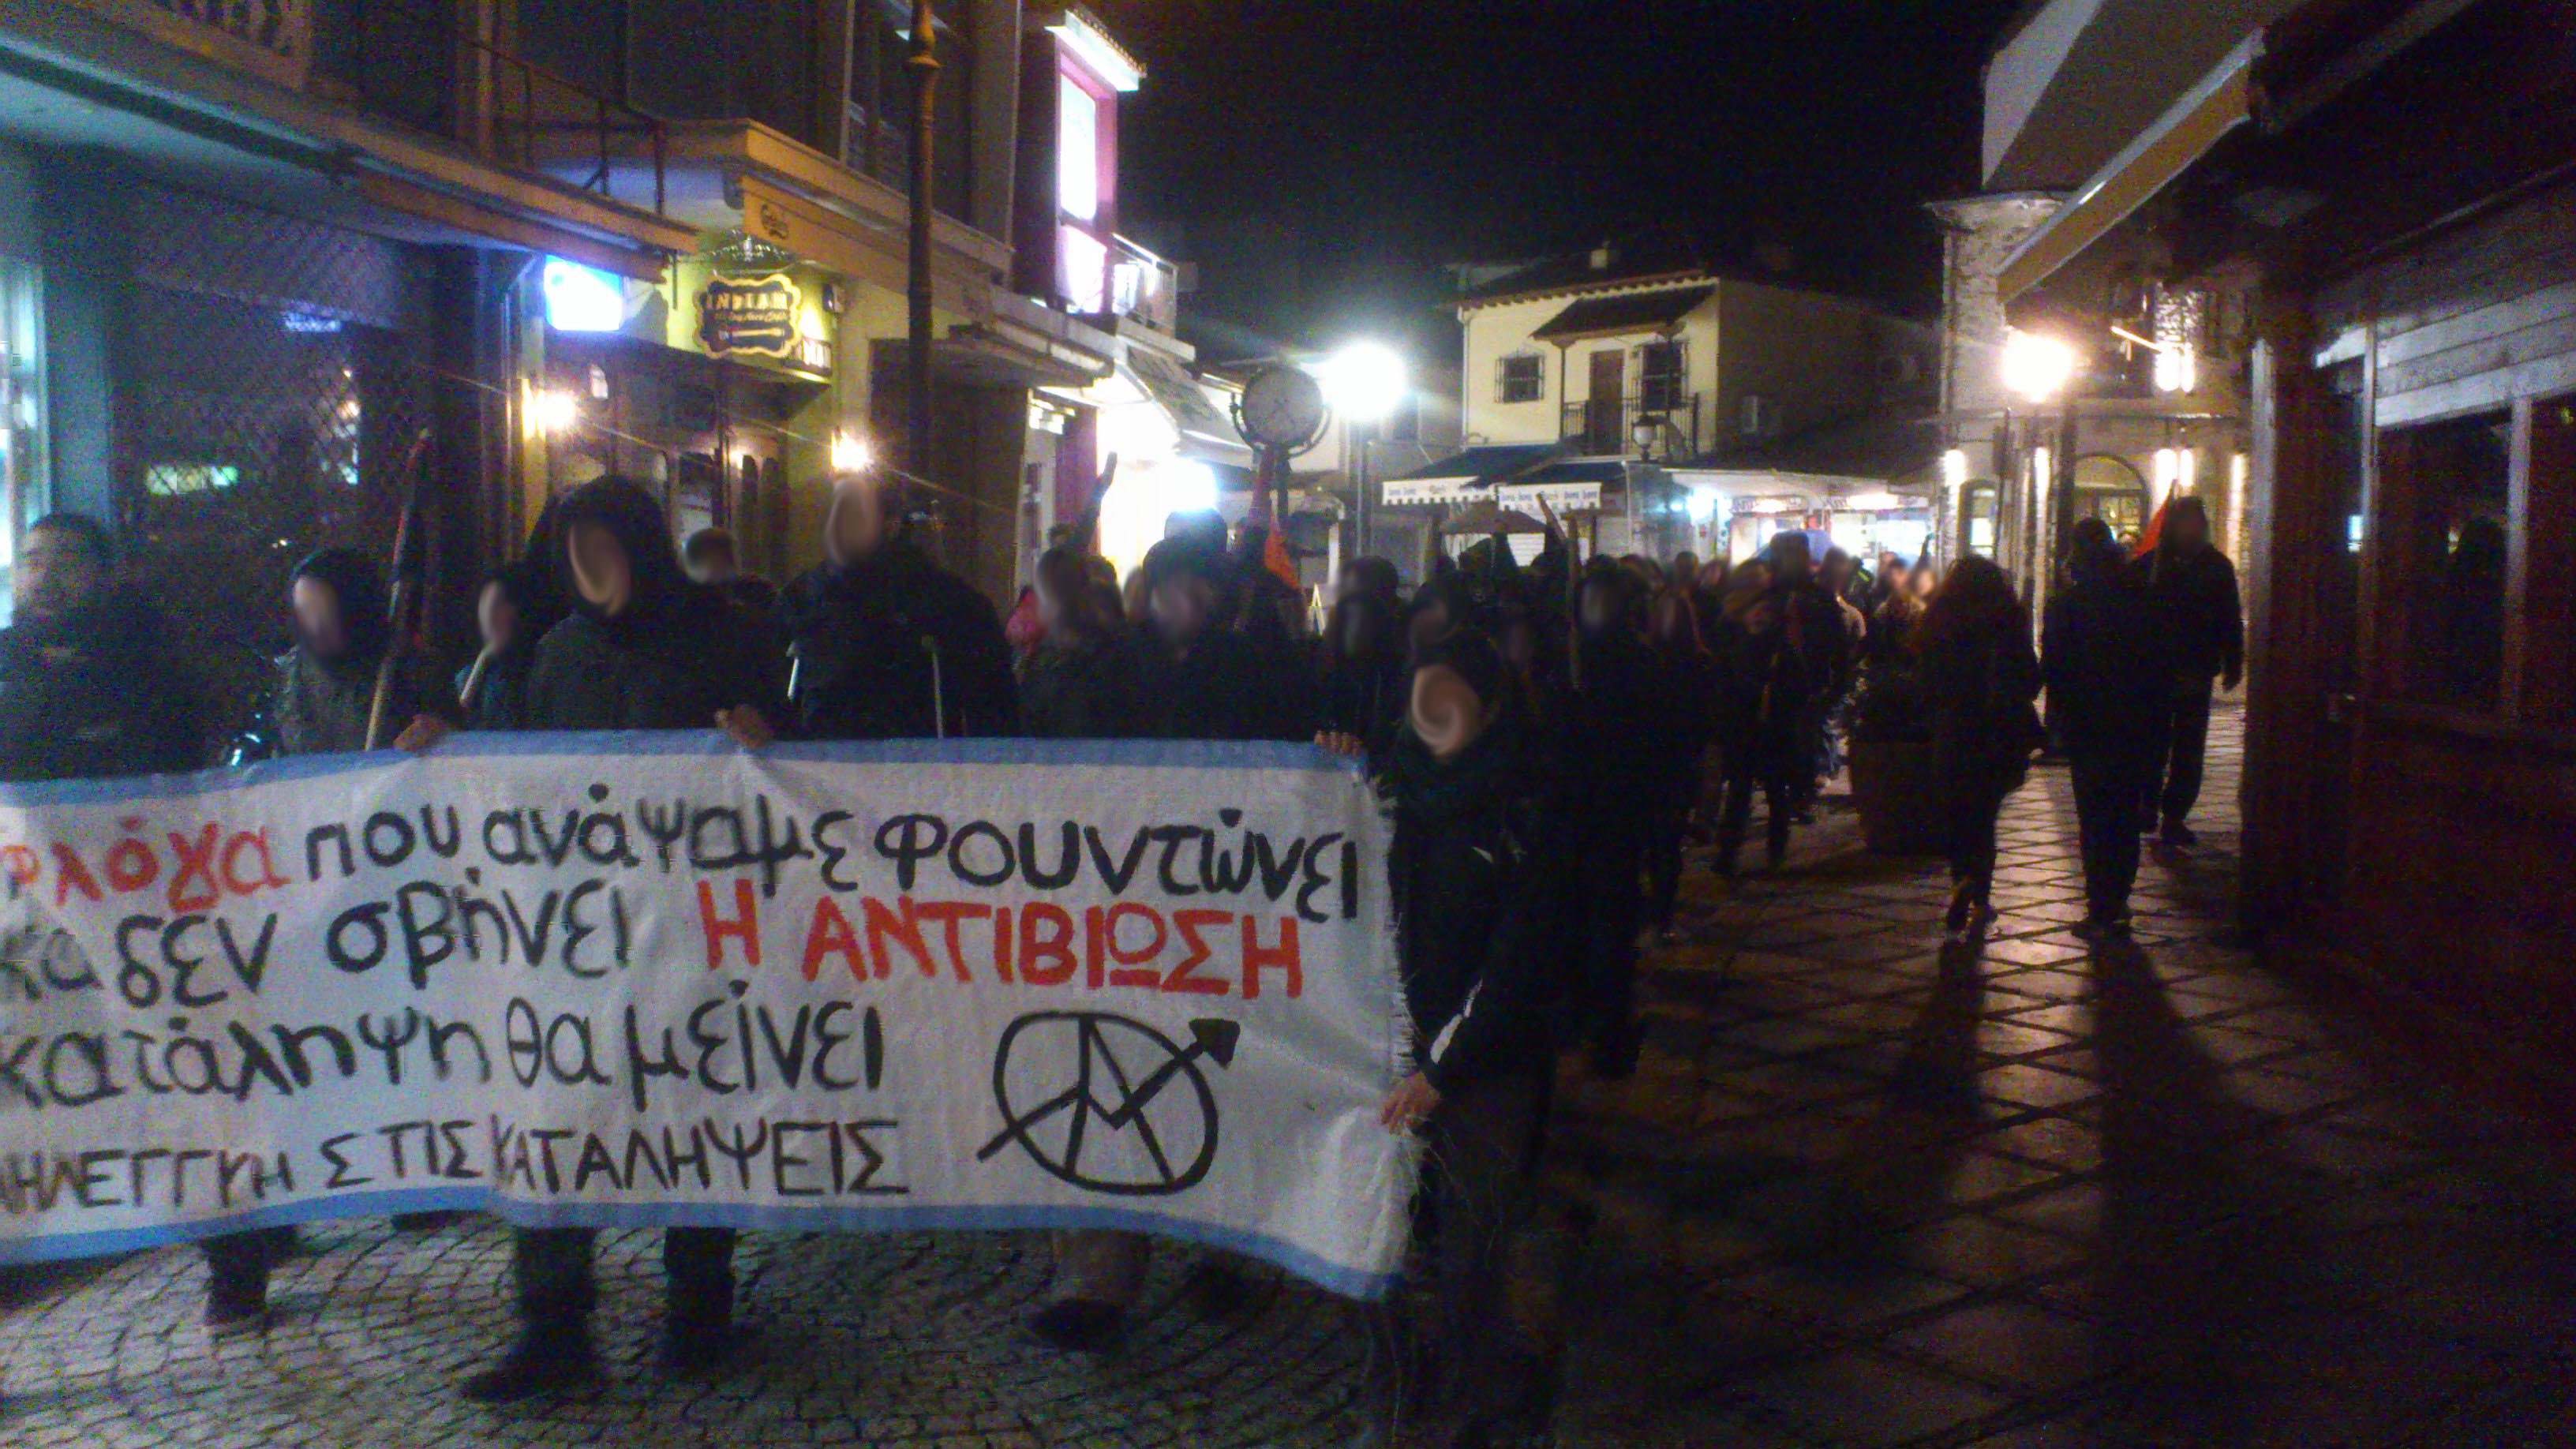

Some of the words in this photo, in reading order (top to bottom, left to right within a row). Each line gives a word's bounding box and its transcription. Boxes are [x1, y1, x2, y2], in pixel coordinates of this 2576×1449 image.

[305, 803, 462, 882] που
[482, 783, 859, 898] ανάψαμε
[115, 912, 278, 1008] δεν
[326, 867, 630, 990] σβήνει
[696, 878, 761, 970] Η
[801, 897, 1303, 1000] ΑΝΤΙΒΙΩΣΗ
[505, 996, 612, 1088] θα
[624, 979, 883, 1113] μείνει
[319, 1121, 485, 1188] ΣΤΙΣ
[489, 1114, 909, 1196] ΚΑΤΑΛΗΨΕΙΣ
